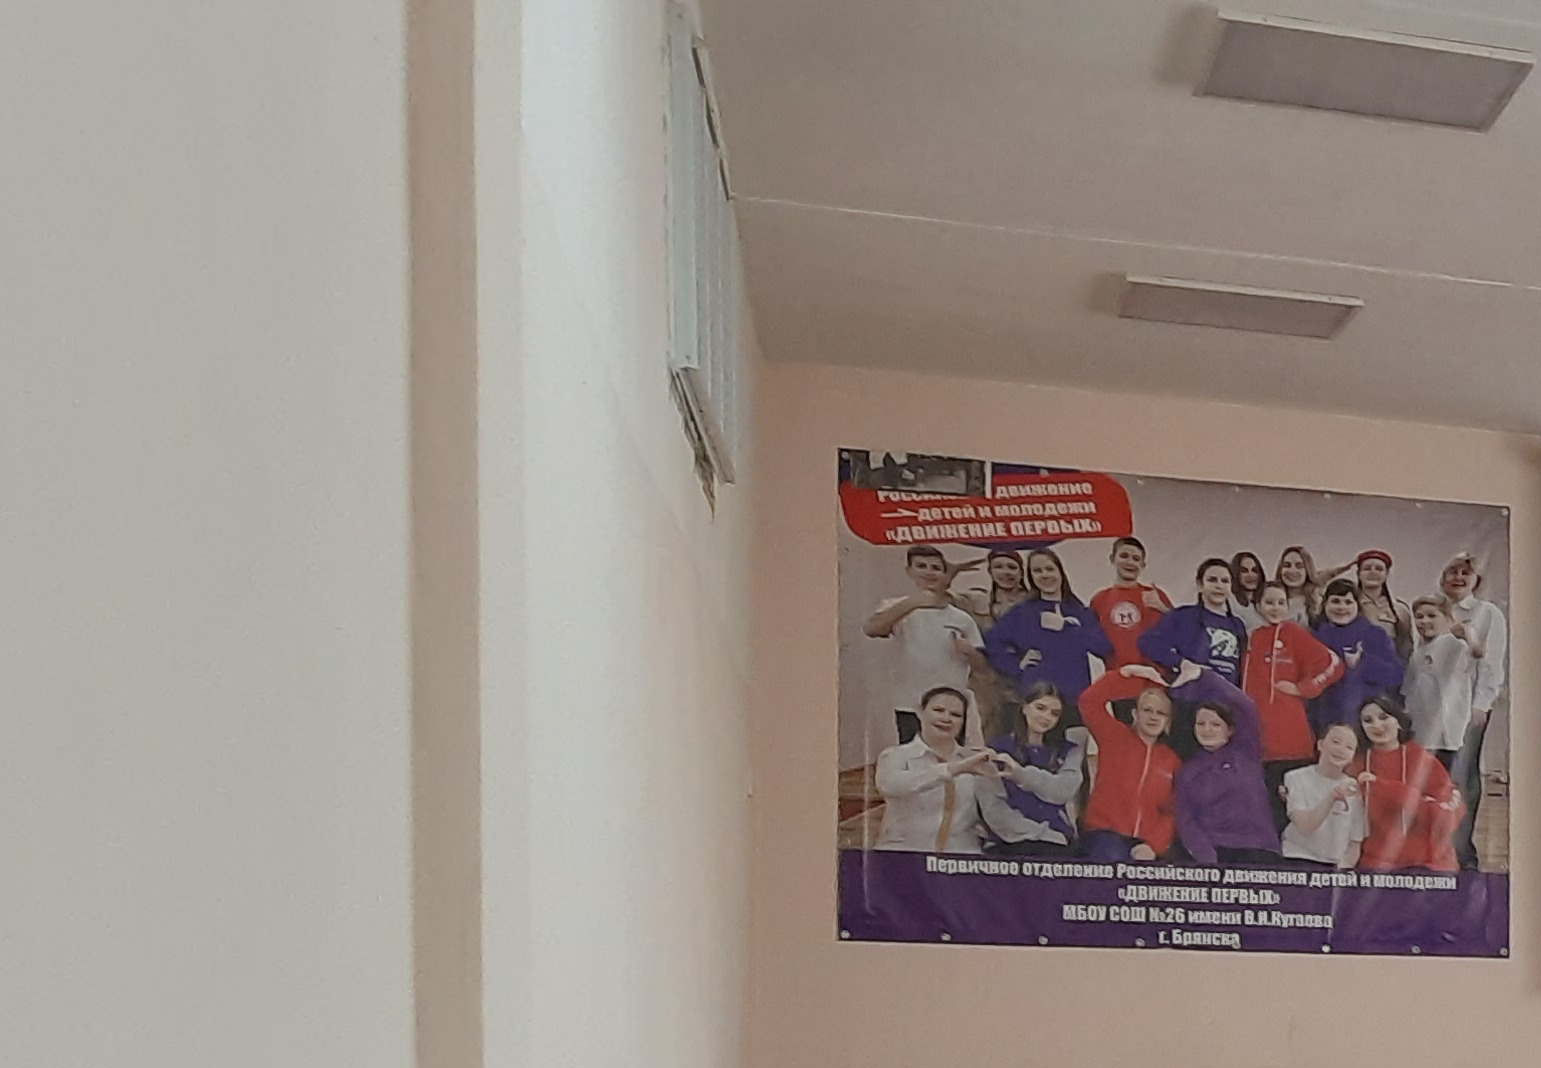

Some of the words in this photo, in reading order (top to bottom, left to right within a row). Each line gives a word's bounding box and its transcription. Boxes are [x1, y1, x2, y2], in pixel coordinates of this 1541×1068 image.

[995, 482, 1093, 499] движение
[917, 504, 977, 522] детей
[979, 502, 993, 518] и
[995, 500, 1097, 520] молодежи
[885, 521, 1008, 543] «ДВИЖЕНИЕ
[1010, 518, 1102, 537] ПЕРВЫХ»
[926, 856, 1019, 875] Первичное
[1022, 862, 1113, 879] отделение
[1116, 863, 1220, 883] Российского
[1222, 868, 1308, 886] движения
[1309, 871, 1357, 888] детей
[1360, 875, 1372, 888] и
[1373, 873, 1457, 892] молодежи
[1118, 885, 1209, 903] «ДВИЖЕНИЕ
[1211, 888, 1281, 906] ПЕРВЫХ»
[1062, 904, 1106, 922] МБОУ
[1109, 906, 1146, 923] СОШ
[1149, 907, 1185, 924] №26
[1188, 910, 1241, 925] имени
[1172, 929, 1241, 949] Брянска
